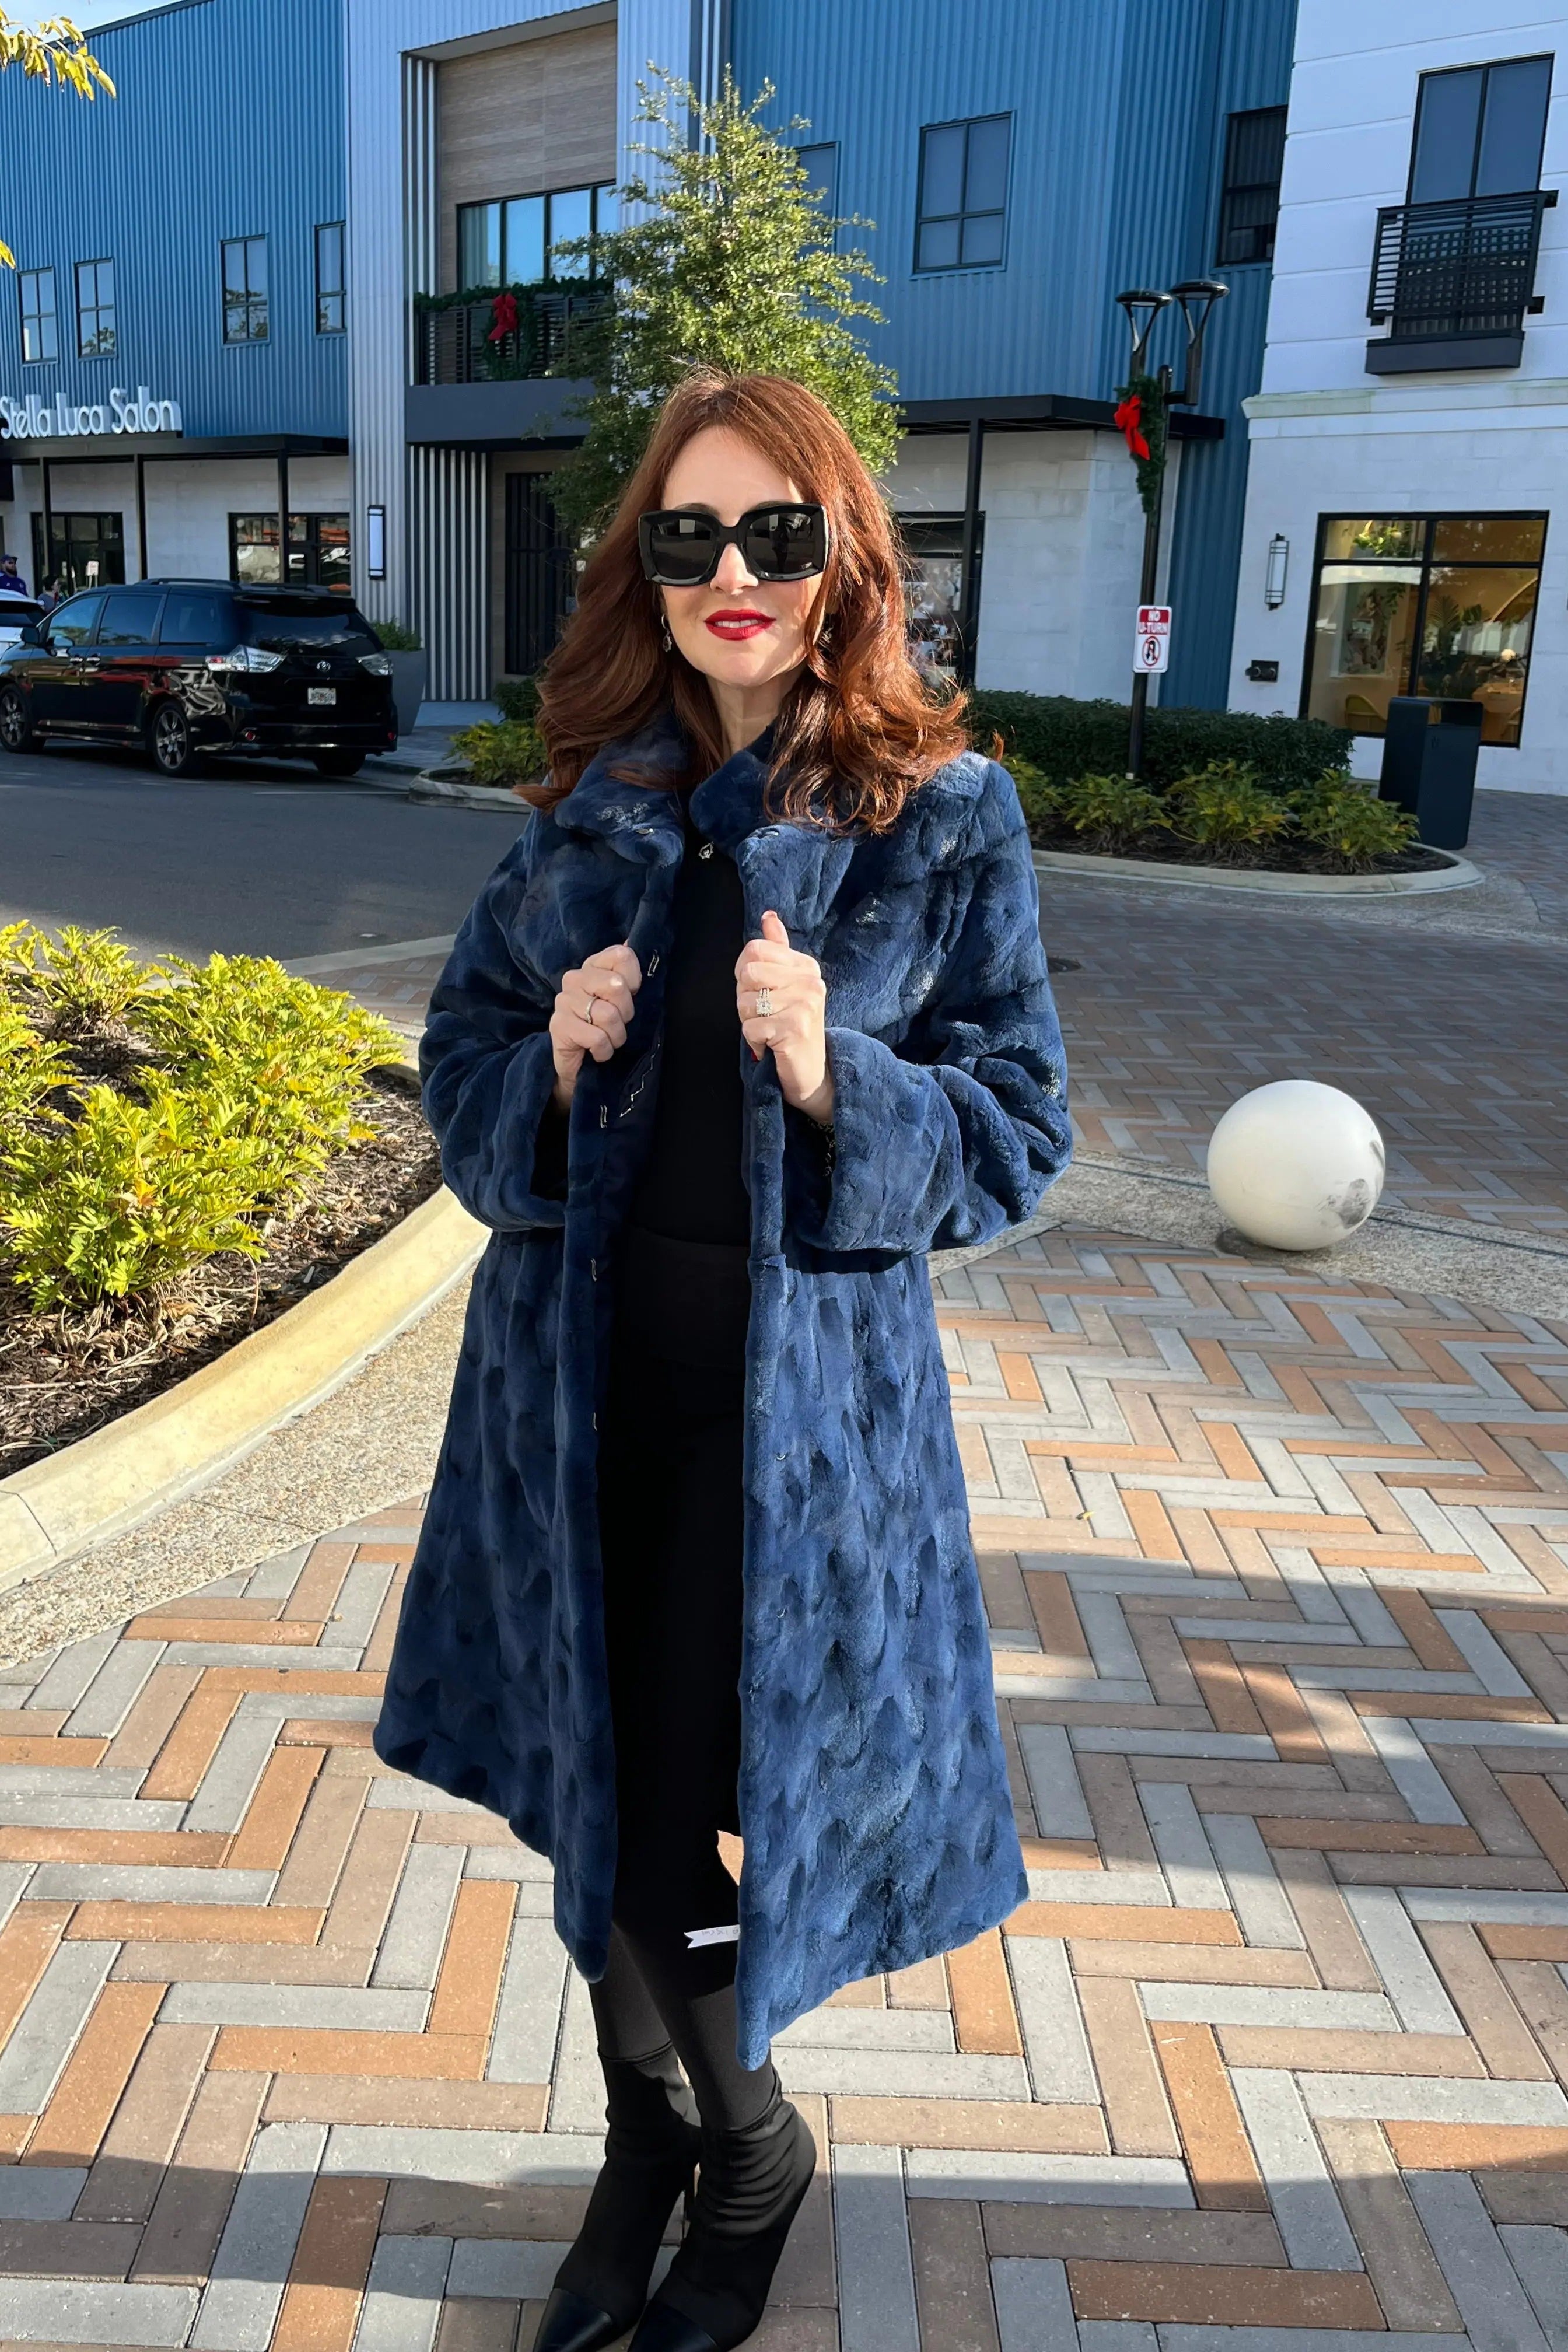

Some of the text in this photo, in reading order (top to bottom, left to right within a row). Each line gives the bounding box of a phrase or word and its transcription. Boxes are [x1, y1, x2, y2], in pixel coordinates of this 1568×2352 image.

[0, 386, 182, 439] Stella Luca Salon
[1148, 611, 1161, 621] NO
[1139, 622, 1167, 633] U-TURN
